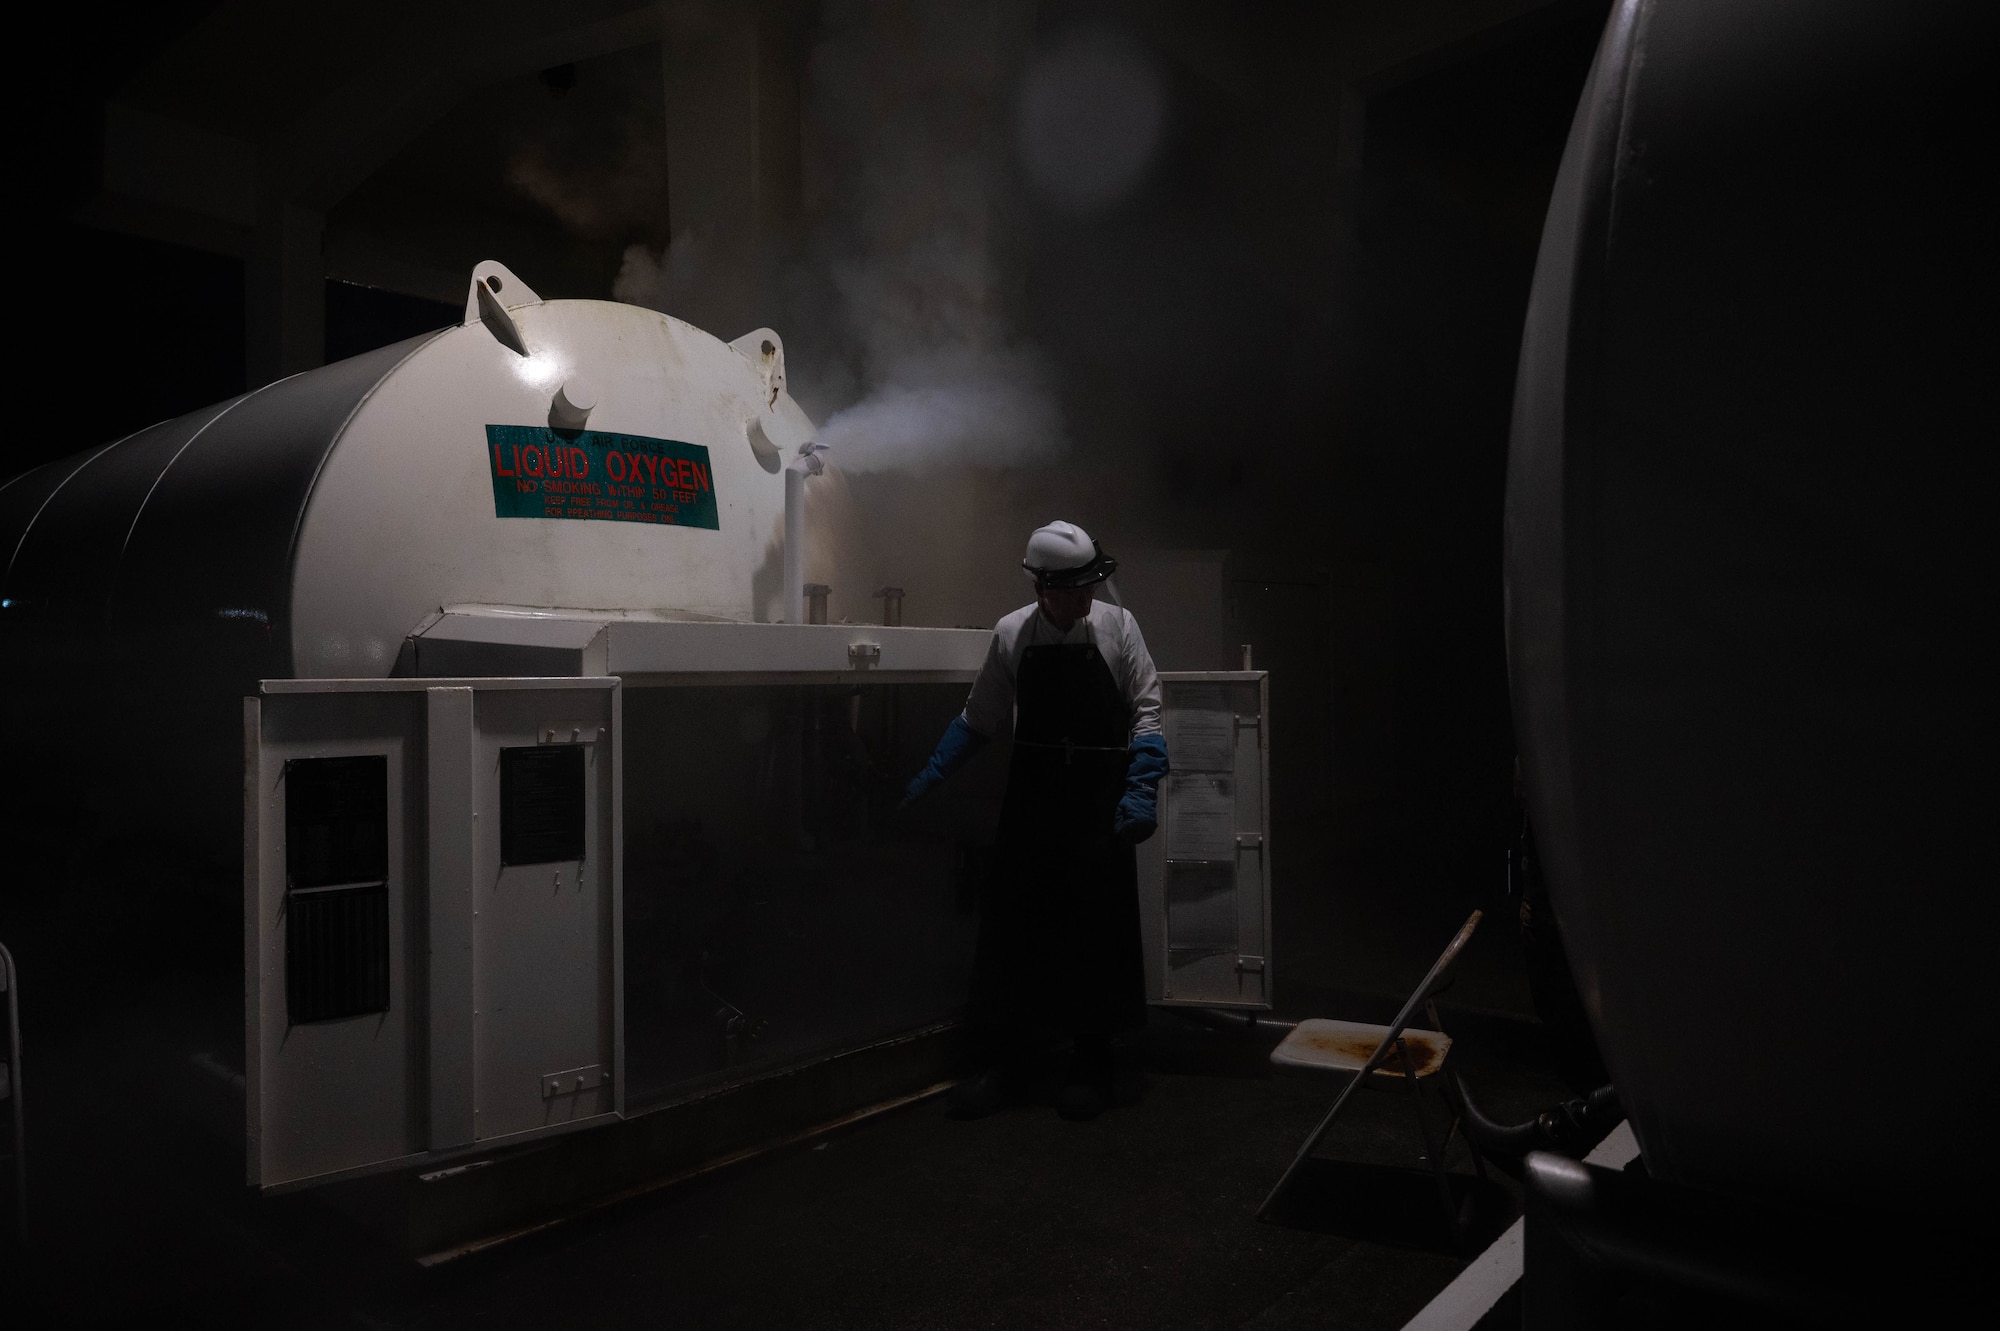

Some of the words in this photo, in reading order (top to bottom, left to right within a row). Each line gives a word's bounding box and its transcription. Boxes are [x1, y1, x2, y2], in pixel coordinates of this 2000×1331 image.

[592, 436, 614, 449] AIR
[621, 438, 665, 455] FORCE
[494, 444, 589, 479] LIQUID
[605, 450, 709, 492] OXYGEN
[516, 480, 537, 493] NO
[543, 480, 602, 496] SMOKING
[607, 484, 646, 499] WITHIN
[652, 488, 667, 500] 50
[672, 490, 698, 504] FEET
[544, 495, 566, 505] KEEP
[570, 496, 592, 507] FREE
[595, 497, 619, 508] FROM
[650, 502, 680, 513] GREASE
[545, 506, 563, 517] FOR
[617, 510, 658, 522] PURPOSES
